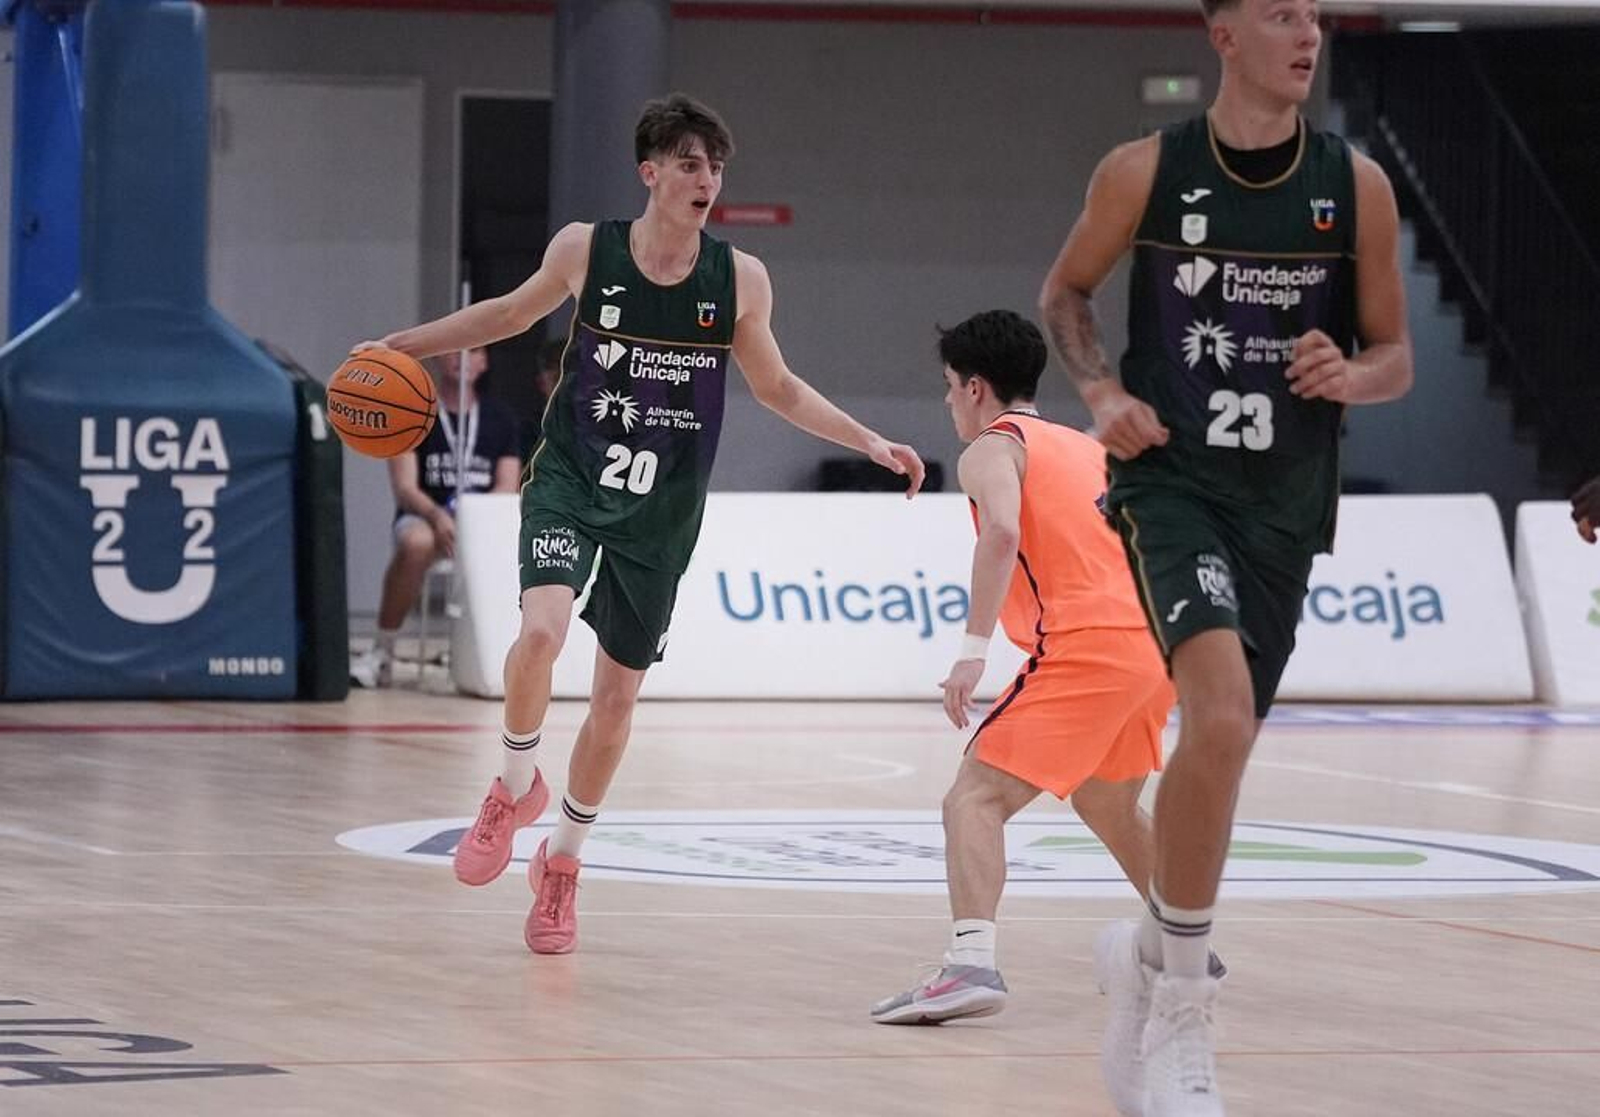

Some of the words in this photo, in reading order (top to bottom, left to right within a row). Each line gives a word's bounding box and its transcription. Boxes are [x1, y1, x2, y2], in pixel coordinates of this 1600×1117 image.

[1223, 263, 1327, 285] Fundación
[697, 301, 716, 311] LIGA
[1222, 282, 1302, 310] Unicaja
[631, 346, 717, 369] Fundación
[1243, 349, 1263, 362] de
[1265, 349, 1279, 362] la
[629, 362, 690, 385] Unicaja
[329, 398, 388, 430] Wilson
[644, 416, 659, 426] de
[660, 416, 670, 427] la
[672, 417, 702, 430] Torre
[646, 406, 694, 420] Alhaurín
[1207, 390, 1274, 450] 23
[80, 418, 228, 470] LIGA
[599, 443, 658, 495] 20
[537, 557, 575, 571] DENTAL
[717, 569, 969, 639] Unicaja
[1303, 571, 1444, 640] caja
[208, 657, 284, 676] MONDO
